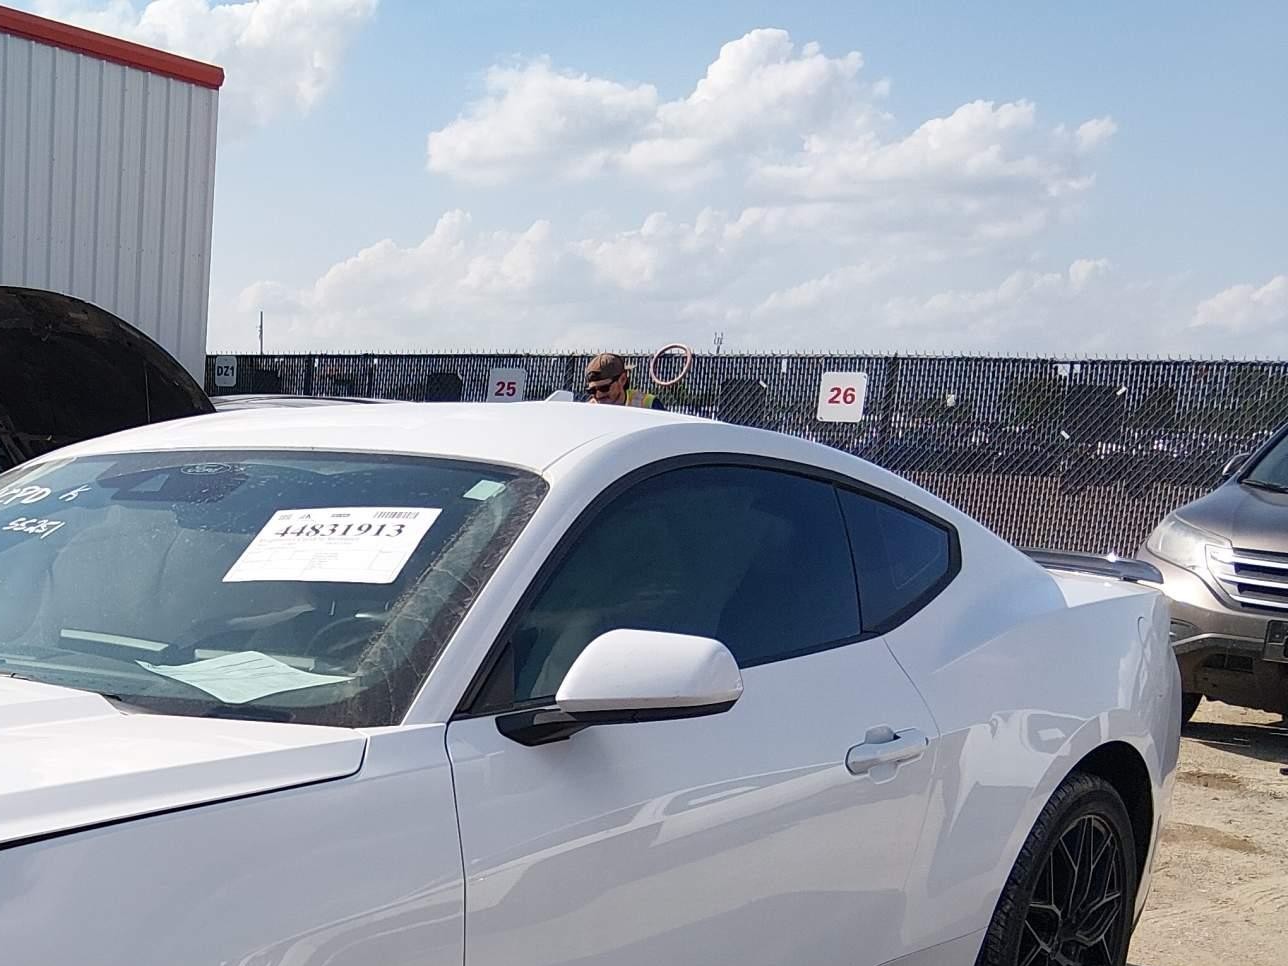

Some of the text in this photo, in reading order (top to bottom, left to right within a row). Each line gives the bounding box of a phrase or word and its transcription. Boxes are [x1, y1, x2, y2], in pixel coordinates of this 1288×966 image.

[217, 365, 234, 377] DZ1
[494, 381, 517, 397] 25
[828, 387, 856, 405] 26
[274, 522, 406, 538] 44831913
